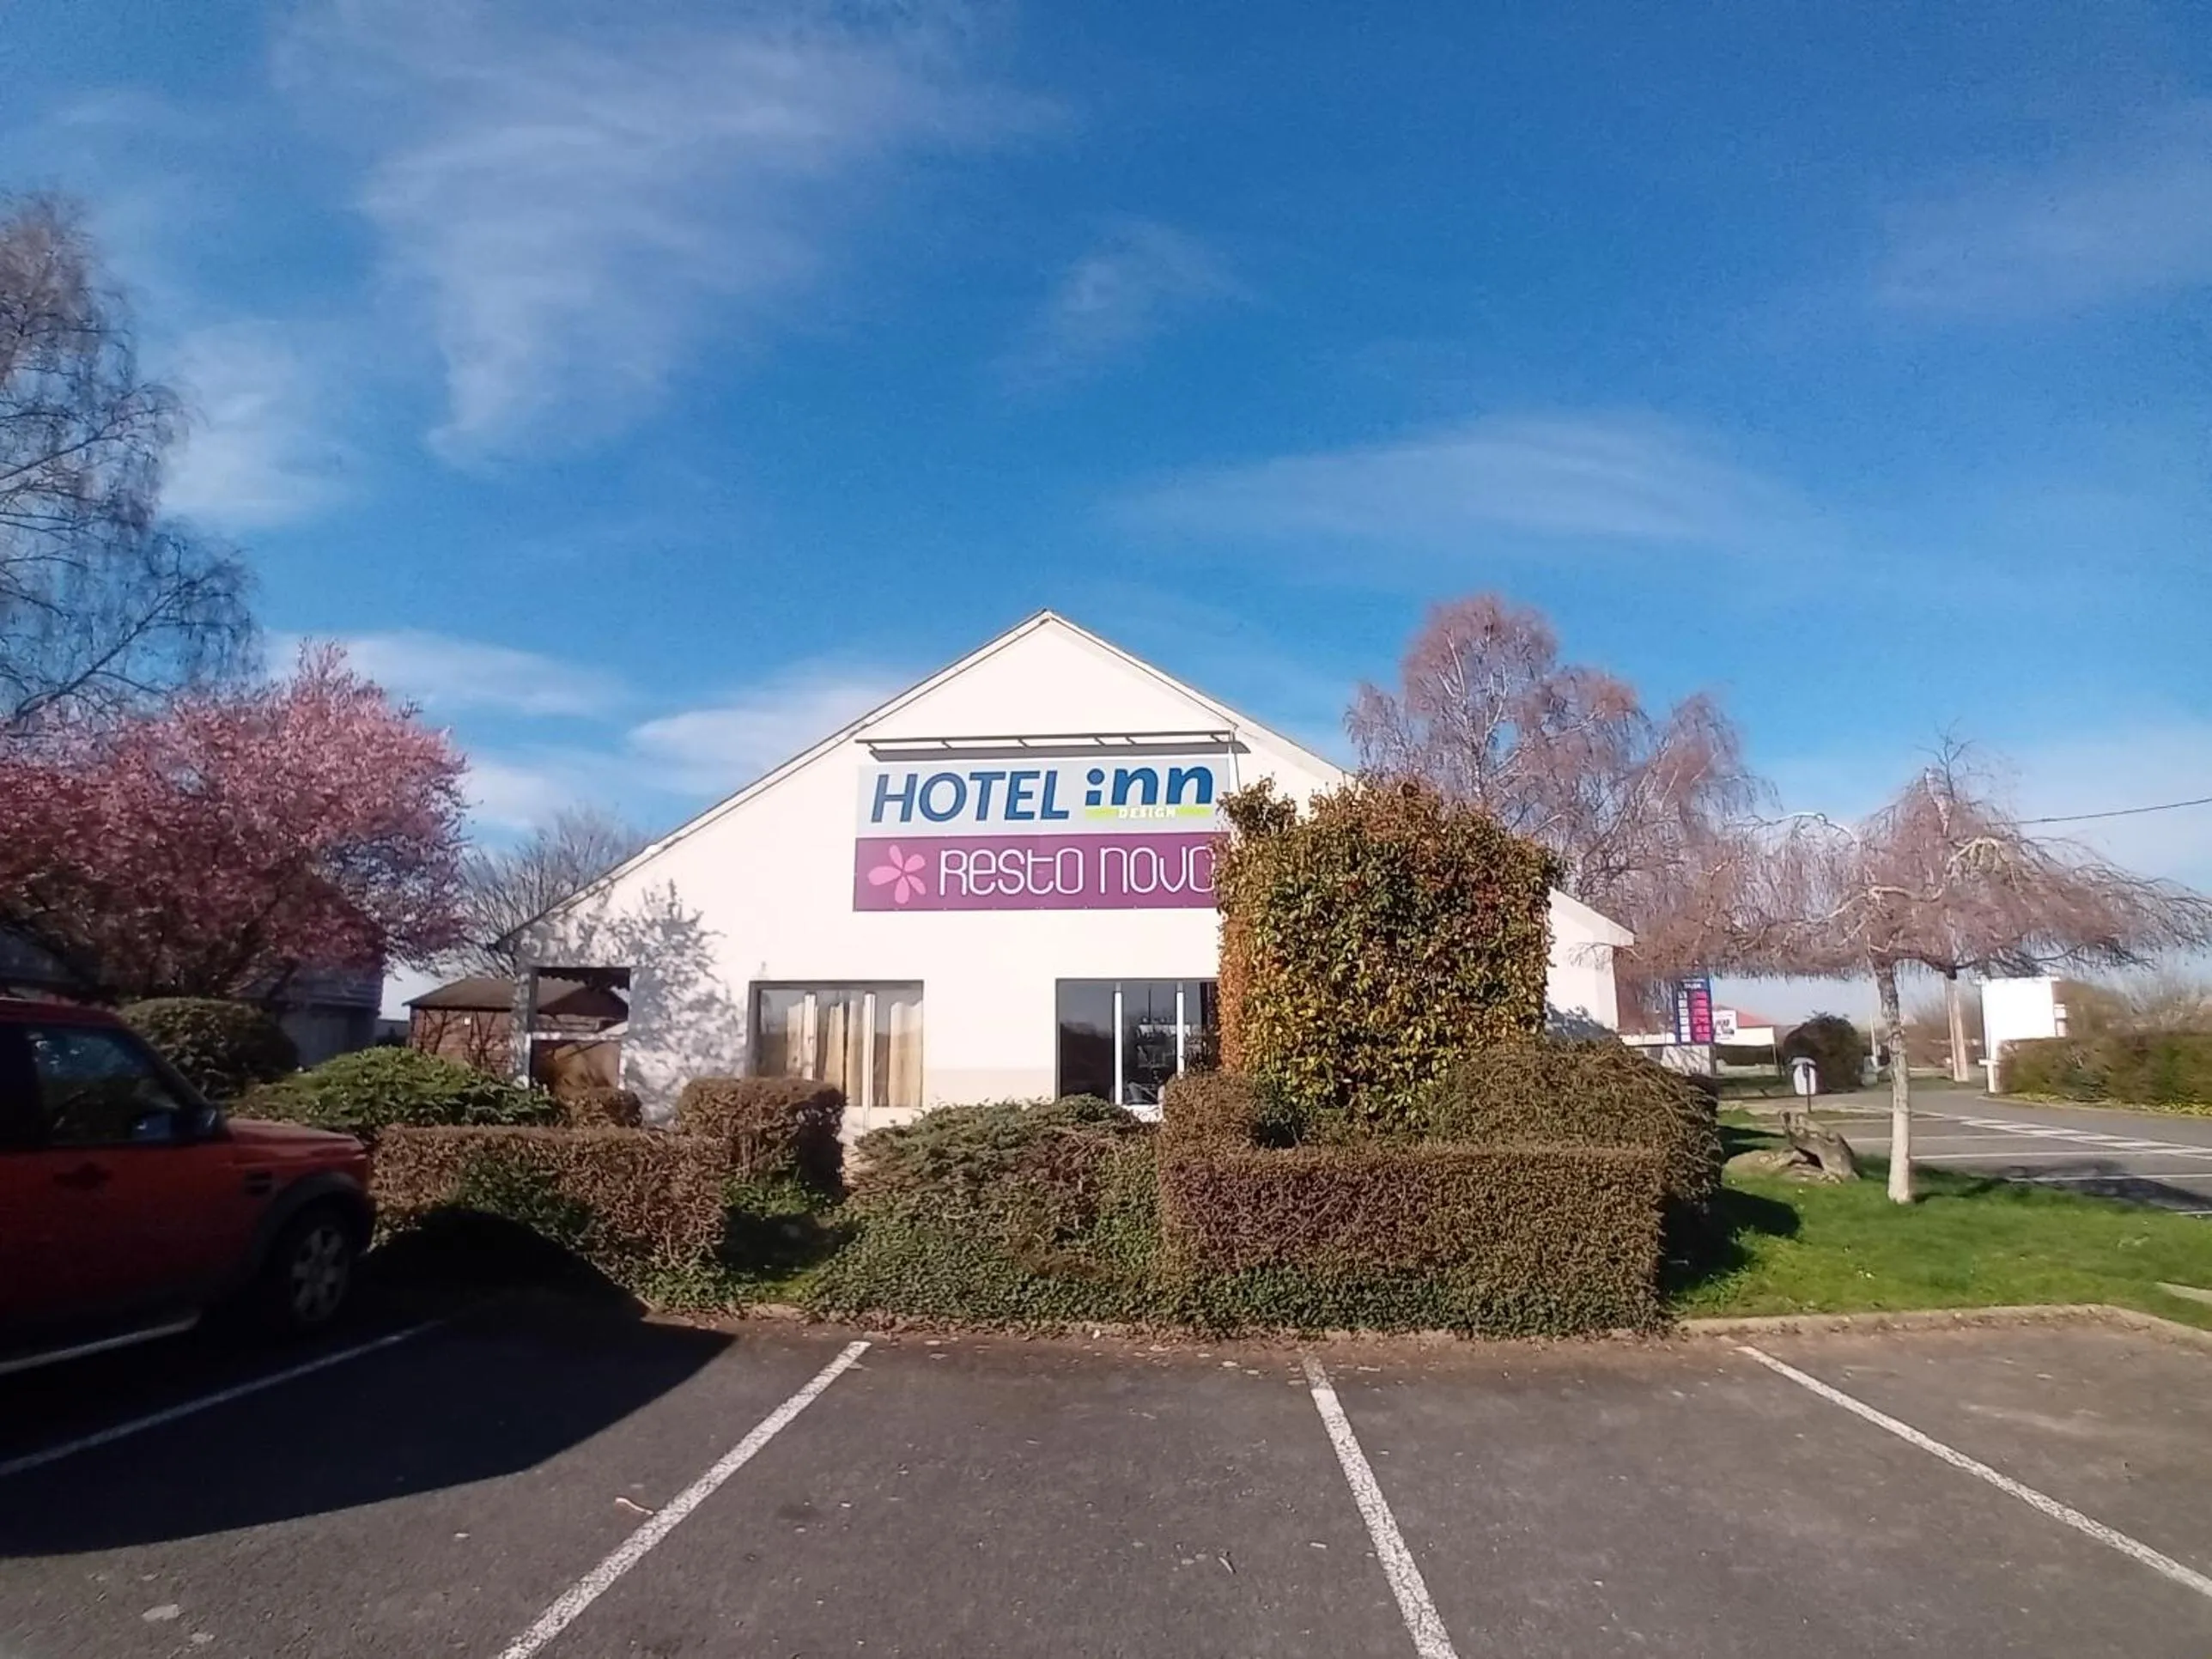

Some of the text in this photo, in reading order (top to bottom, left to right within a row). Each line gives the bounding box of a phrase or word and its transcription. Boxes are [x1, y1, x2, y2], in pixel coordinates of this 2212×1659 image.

[871, 765, 1214, 823] HOTEL inn
[1117, 805, 1176, 819] DESIGN
